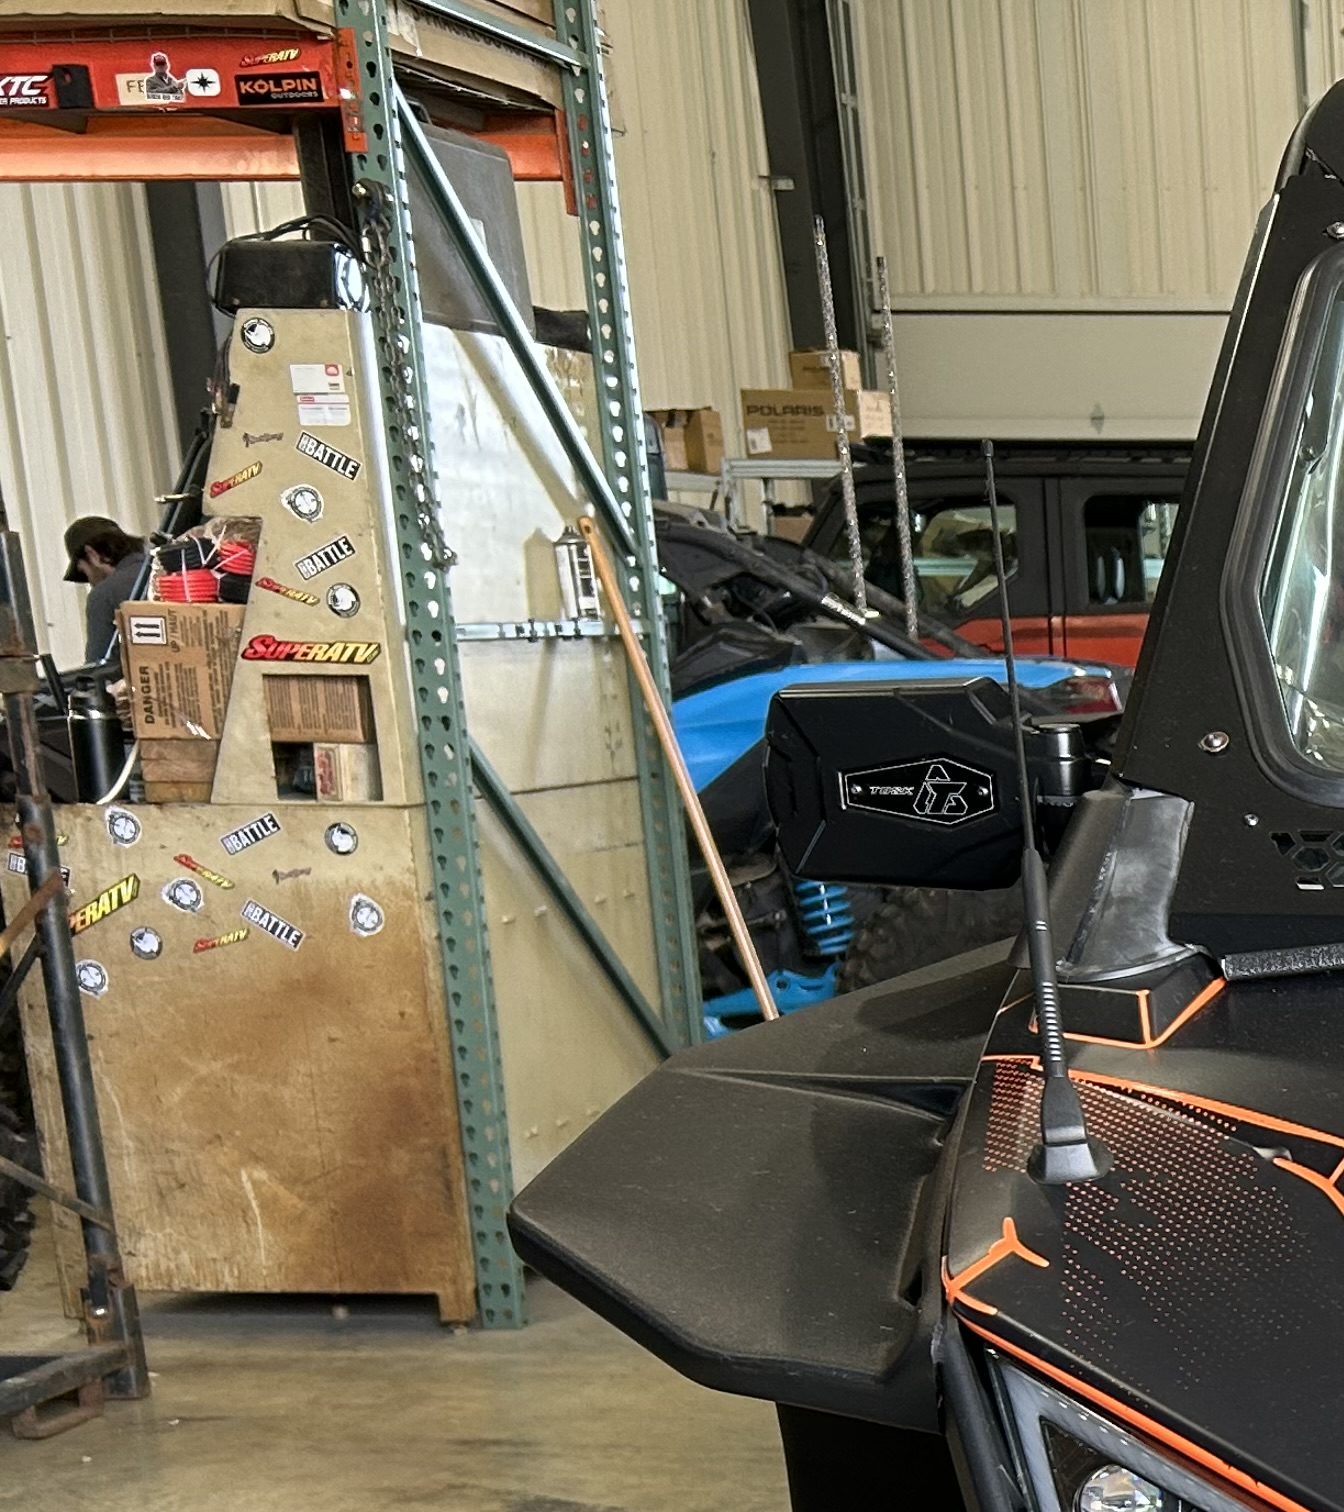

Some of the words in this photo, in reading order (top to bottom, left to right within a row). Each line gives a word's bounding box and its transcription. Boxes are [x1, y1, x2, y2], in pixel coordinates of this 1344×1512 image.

[239, 78, 318, 95] KOLPIN
[270, 91, 319, 100] OUTDOORS
[745, 404, 825, 417] POLARIS
[305, 438, 358, 479] BATTLE
[304, 538, 354, 578] BATTLE
[139, 665, 156, 725] DANGER
[229, 814, 279, 851] BATTLE
[69, 875, 135, 932] ERATV
[250, 904, 302, 947] BATTLE
